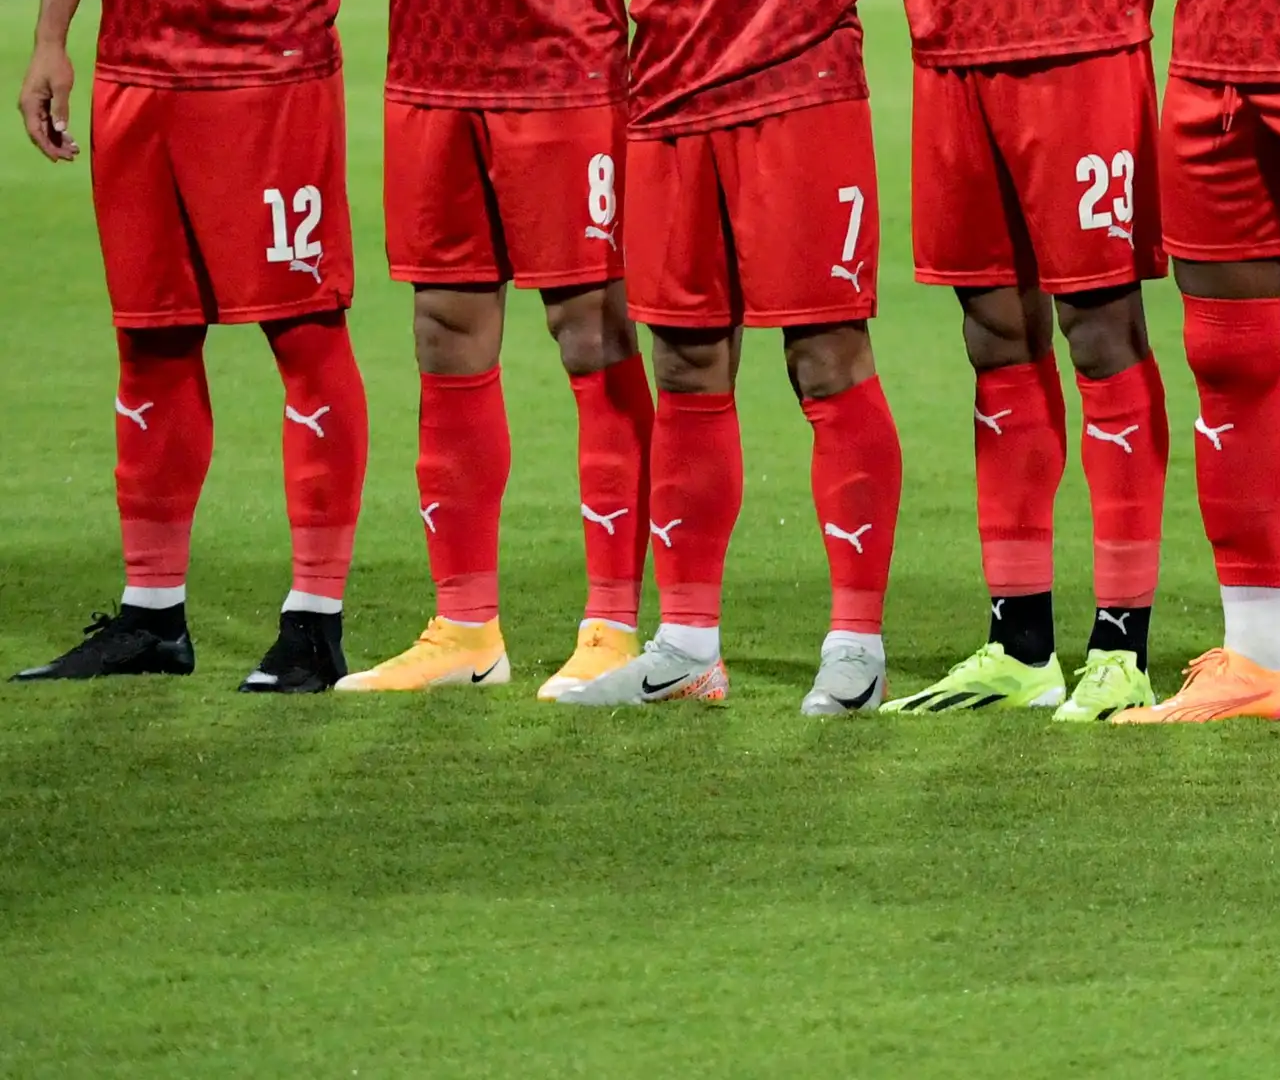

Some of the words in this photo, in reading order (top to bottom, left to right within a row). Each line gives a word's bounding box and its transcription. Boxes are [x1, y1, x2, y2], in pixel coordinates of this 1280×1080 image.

[263, 185, 322, 262] 12
[587, 153, 616, 226] 8
[838, 185, 864, 262] 7
[1075, 149, 1135, 230] 23
